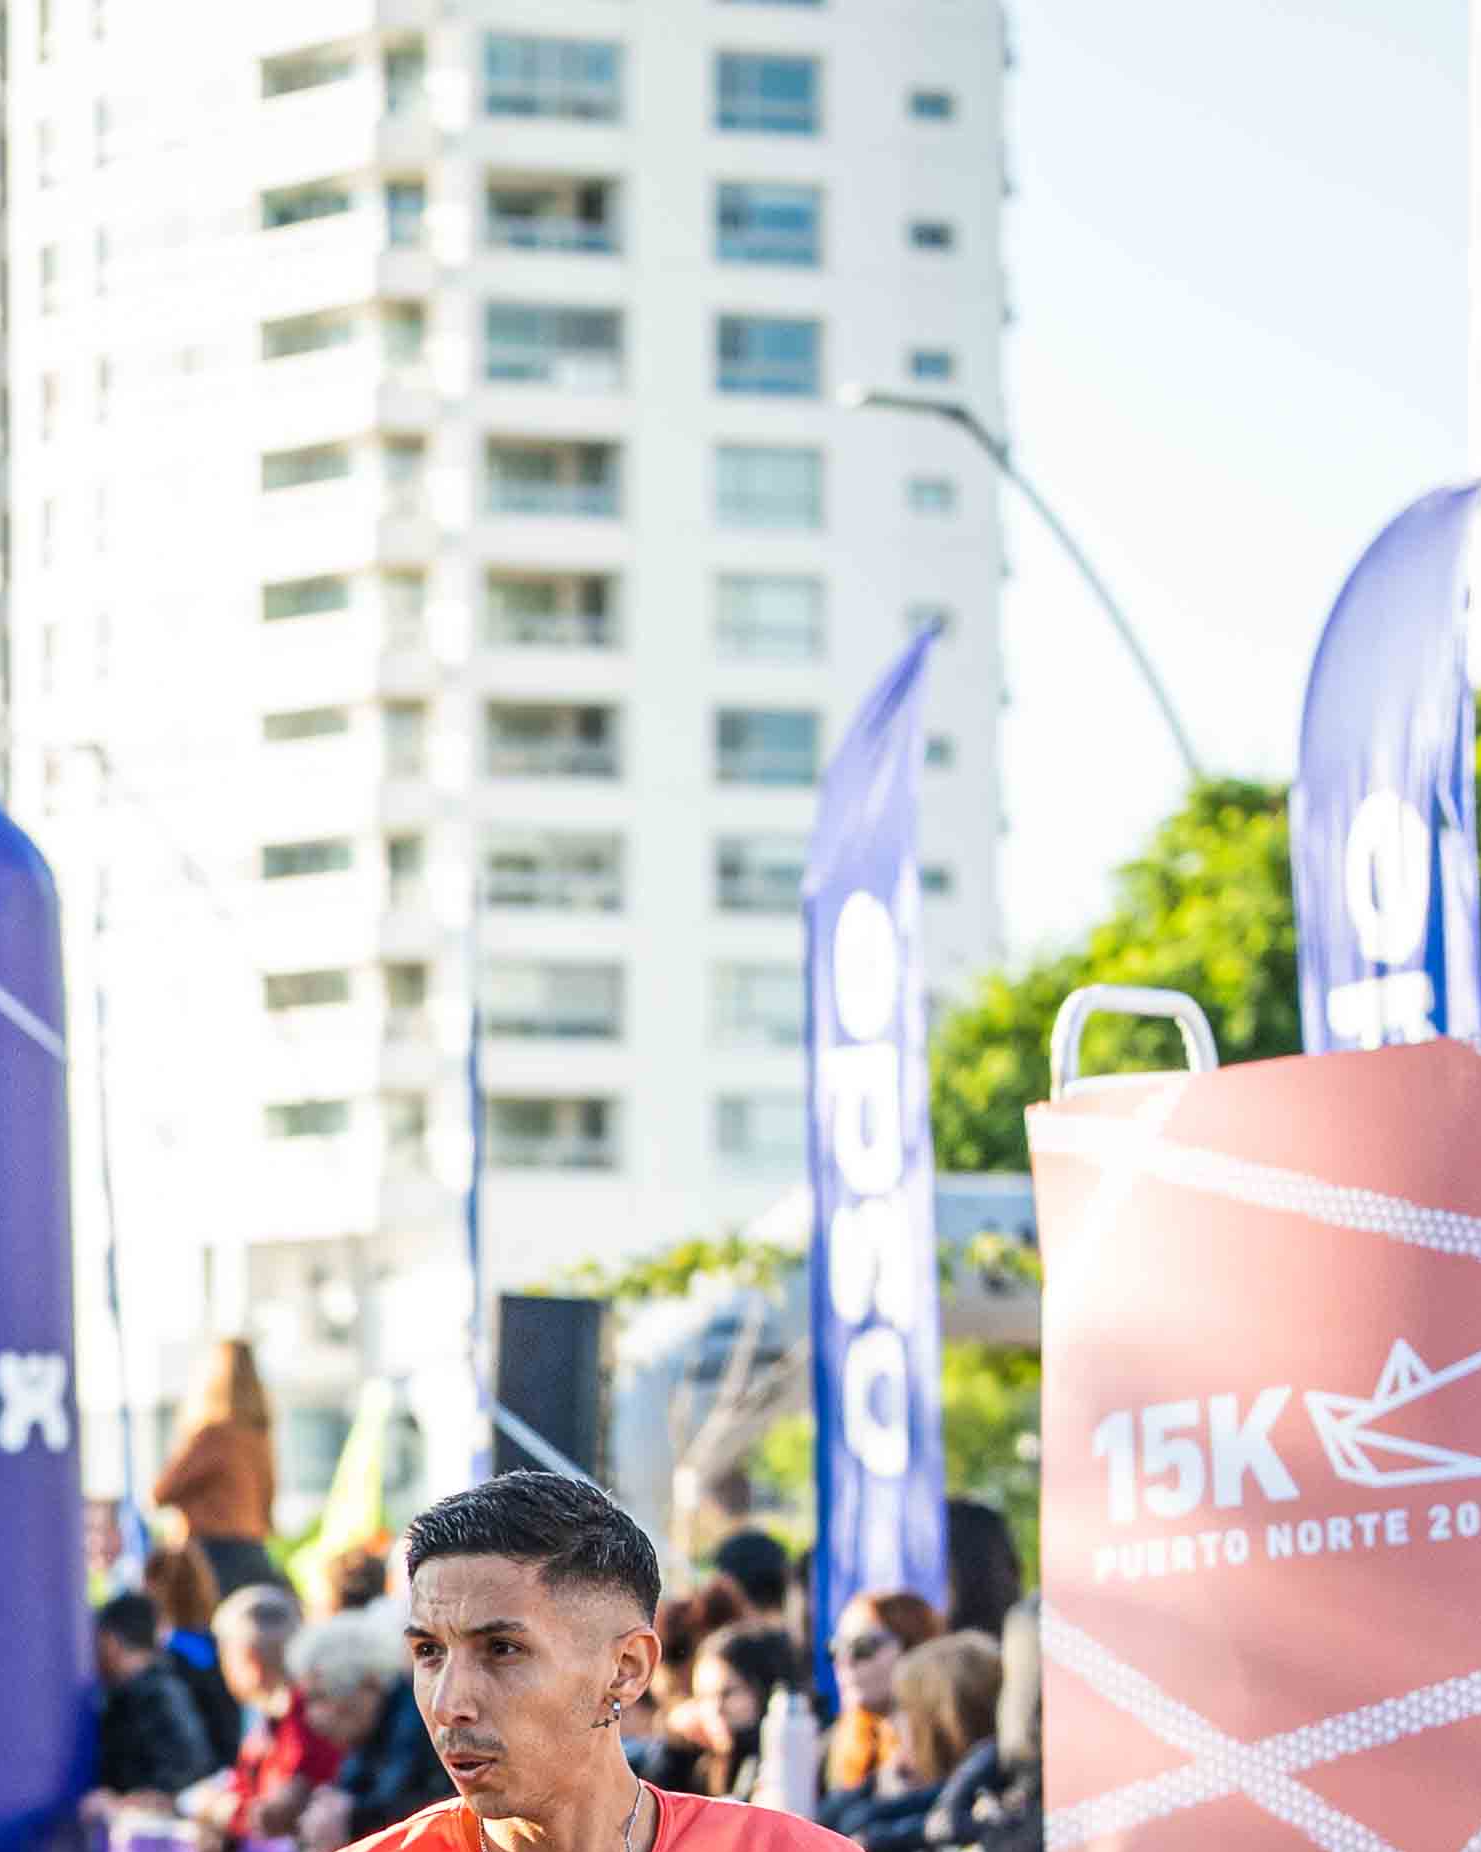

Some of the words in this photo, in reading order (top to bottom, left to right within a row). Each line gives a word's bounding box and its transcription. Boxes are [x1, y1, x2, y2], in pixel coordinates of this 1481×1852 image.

[1091, 1384, 1303, 1527] 15K
[1094, 1528, 1250, 1583] PUERTO
[1265, 1508, 1410, 1561] NORTE
